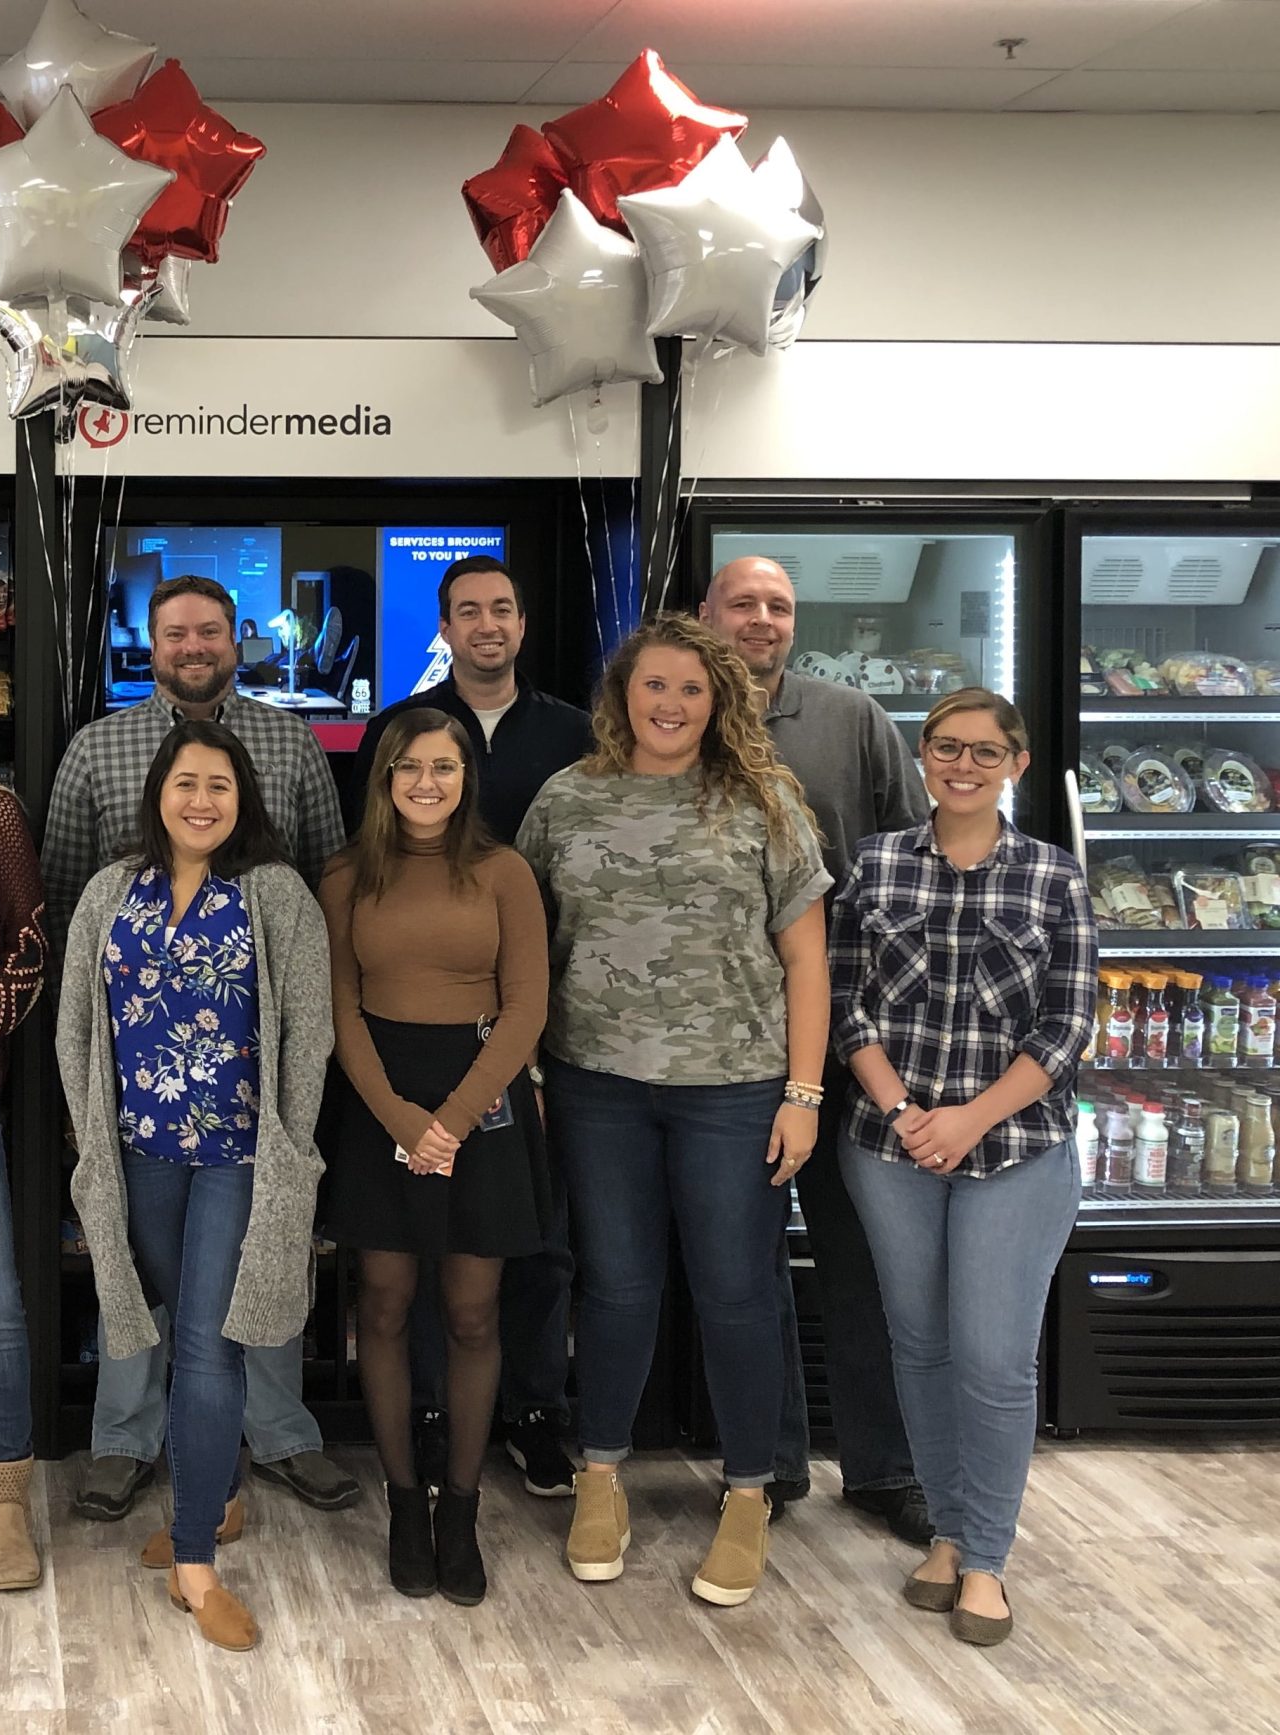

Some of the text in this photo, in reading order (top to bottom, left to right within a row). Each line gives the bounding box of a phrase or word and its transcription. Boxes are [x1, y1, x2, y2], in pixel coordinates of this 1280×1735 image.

[133, 404, 392, 436] remindermedia
[389, 537, 501, 547] SERVICES BROUGHT
[412, 551, 470, 561] TO YOU BY
